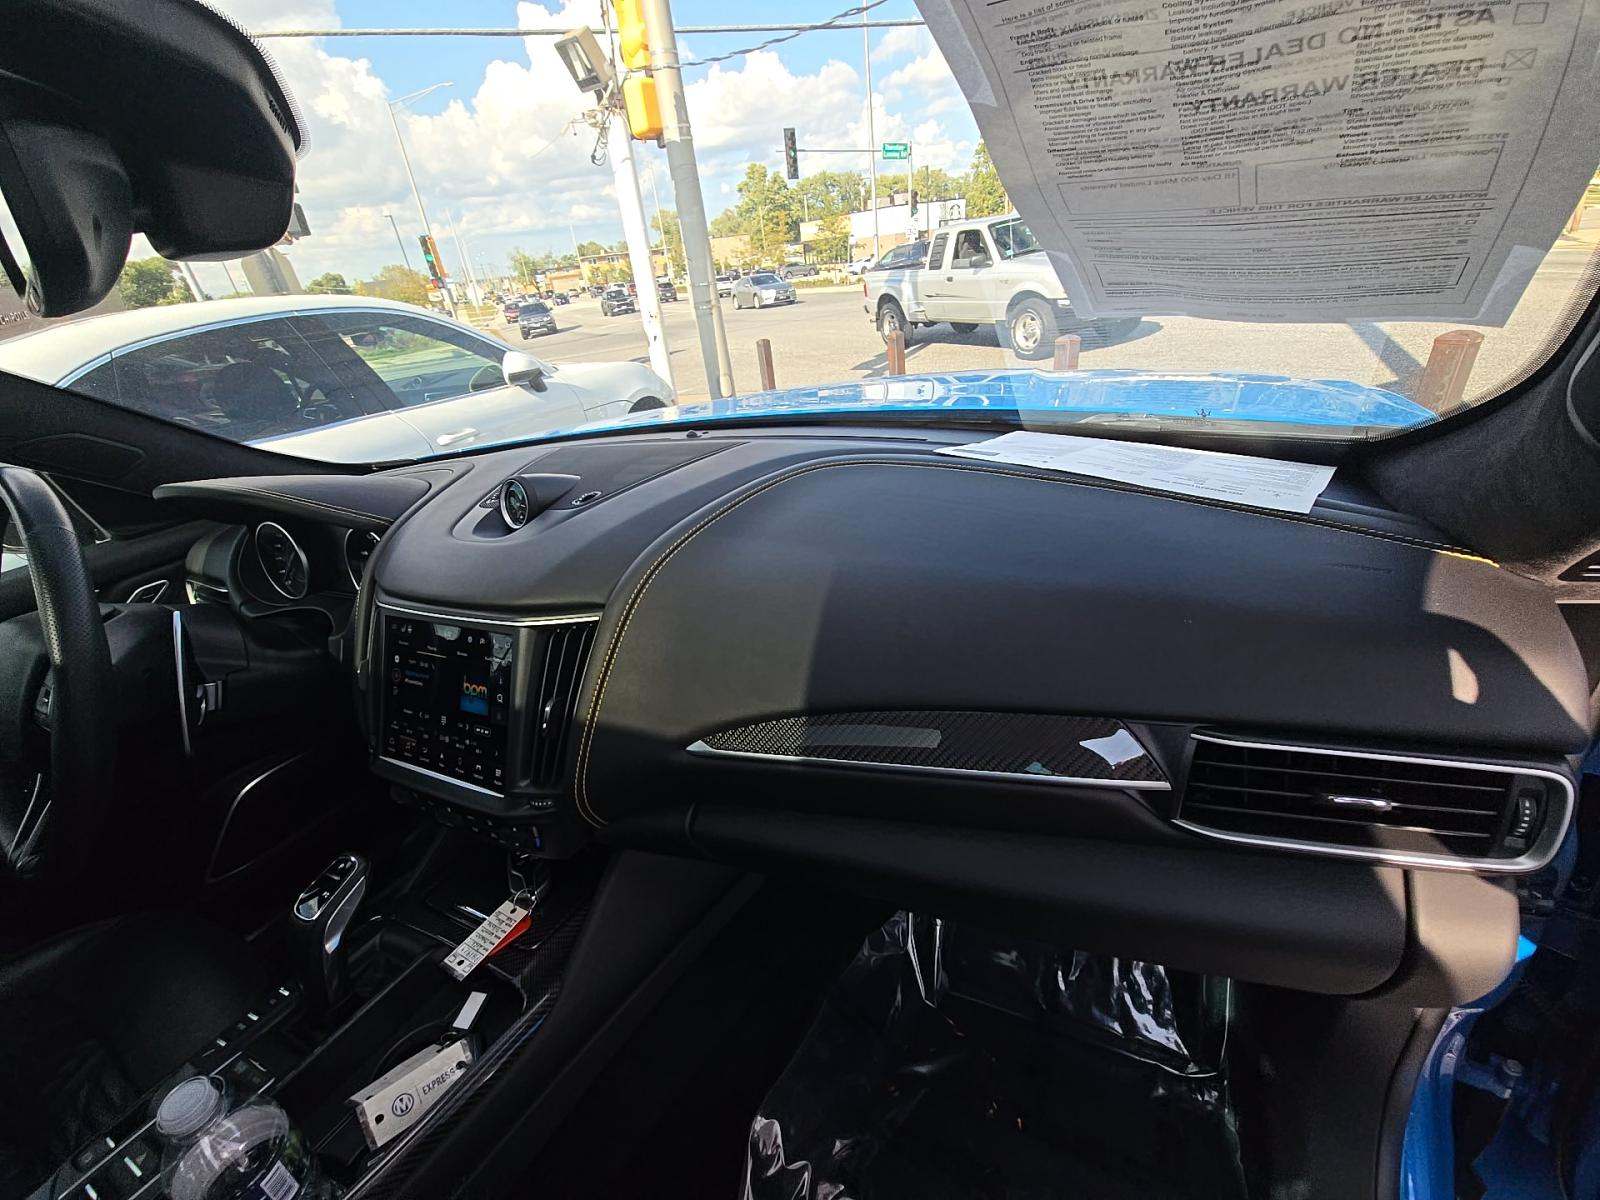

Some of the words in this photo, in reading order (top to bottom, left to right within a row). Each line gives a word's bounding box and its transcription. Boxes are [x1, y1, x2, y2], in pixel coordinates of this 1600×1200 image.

[1162, 0, 1192, 8] Cooling
[1210, 4, 1252, 17] functioning
[1001, 15, 1018, 23] Here
[1165, 24, 1200, 35] Electrical
[1202, 19, 1233, 28] System
[462, 675, 488, 698] bpm
